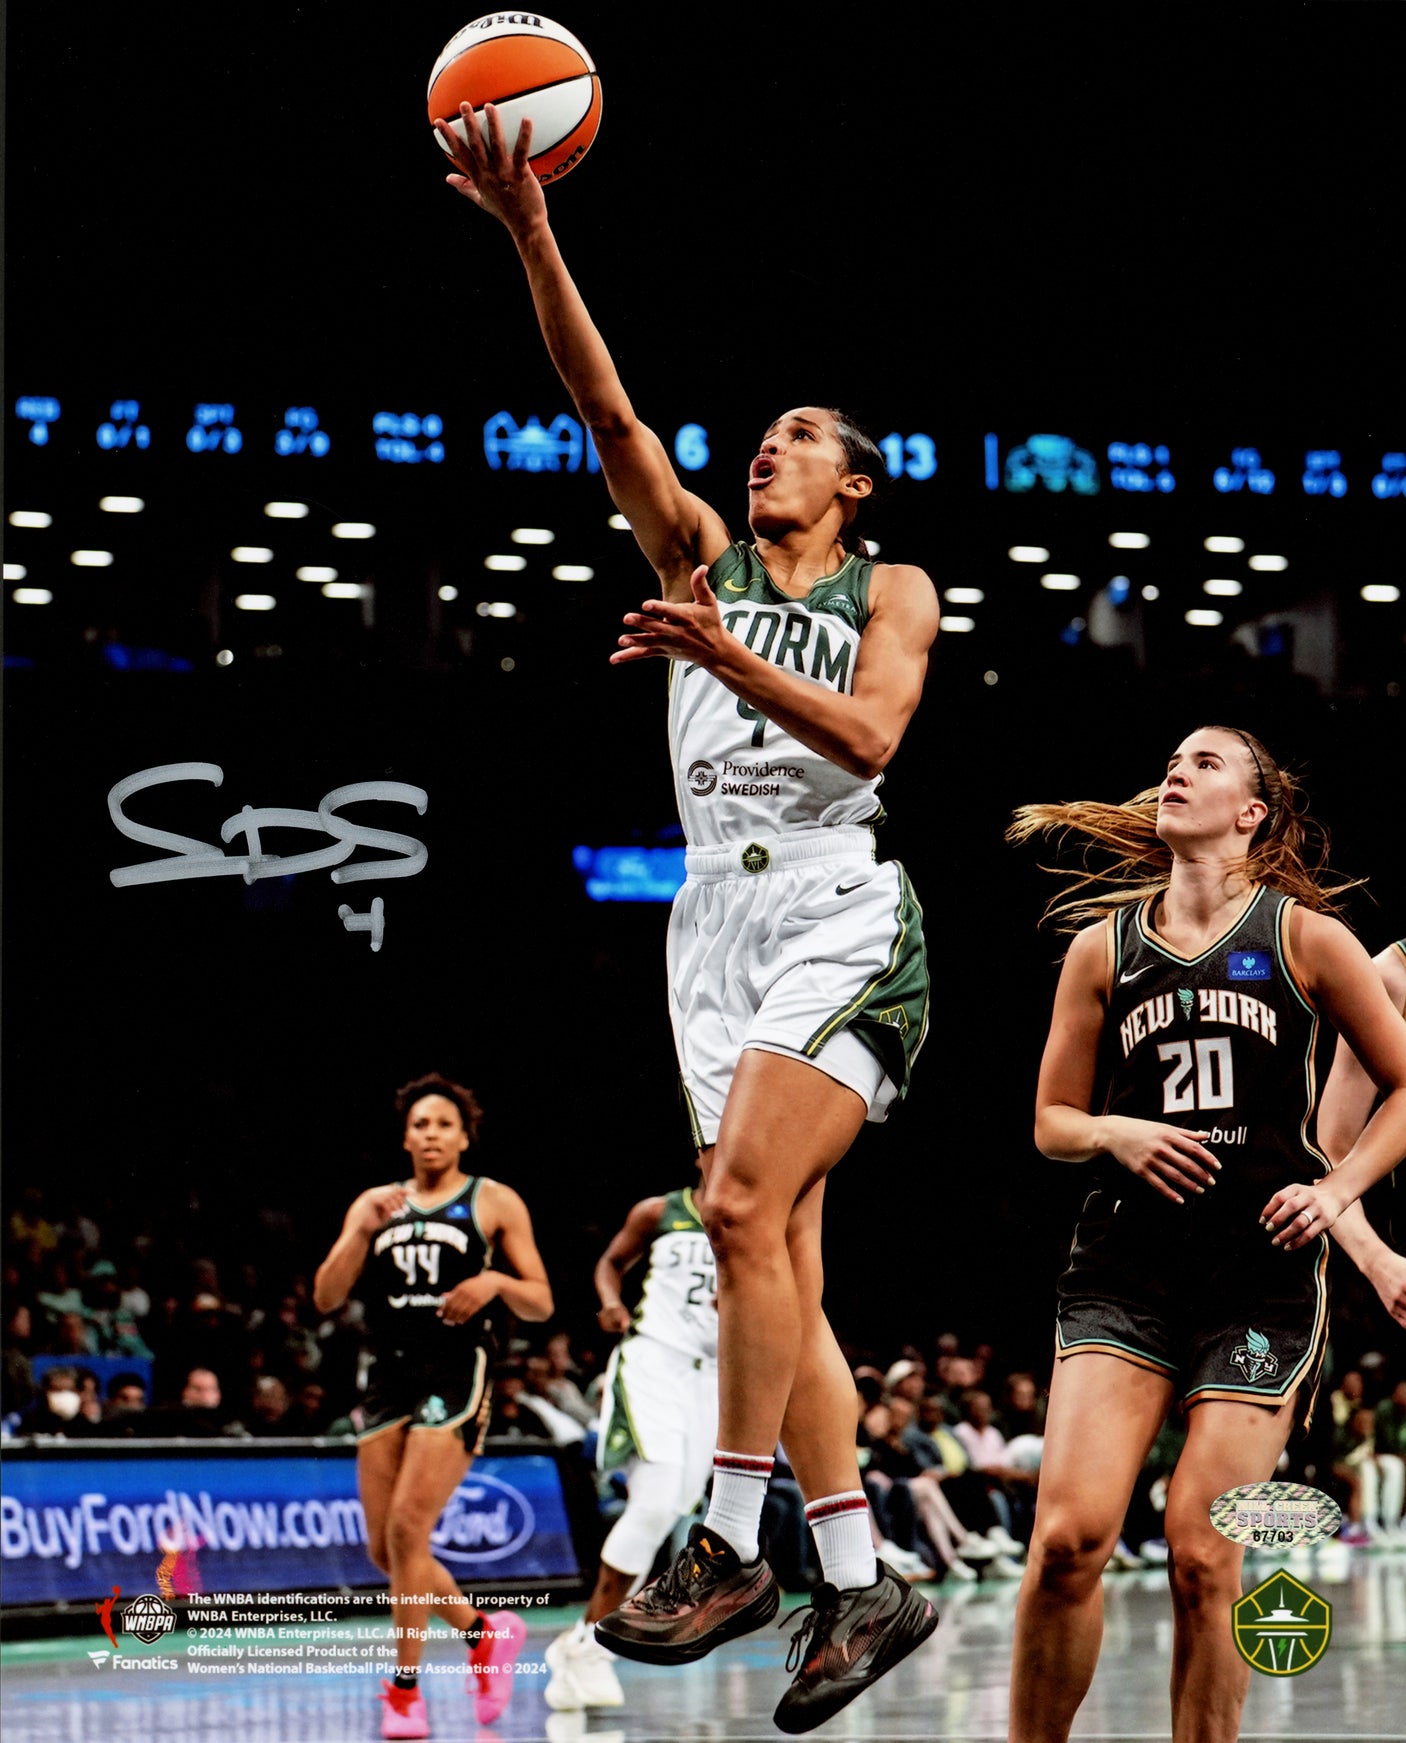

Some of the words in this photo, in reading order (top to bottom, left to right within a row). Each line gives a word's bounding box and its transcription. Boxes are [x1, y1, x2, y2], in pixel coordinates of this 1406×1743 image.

[675, 423, 709, 471] 6
[881, 433, 937, 480] 13
[684, 610, 852, 697] TORM
[721, 782, 780, 796] SWEDISH
[723, 760, 805, 779] Providence
[1119, 992, 1174, 1060] NEW
[1198, 988, 1277, 1047] YORK
[1156, 1036, 1234, 1114] 20
[391, 1243, 441, 1286] 44
[1, 1490, 366, 1570] BuyFordNow.com
[1237, 1512, 1317, 1529] SPORTS
[1253, 1530, 1294, 1543] 67703
